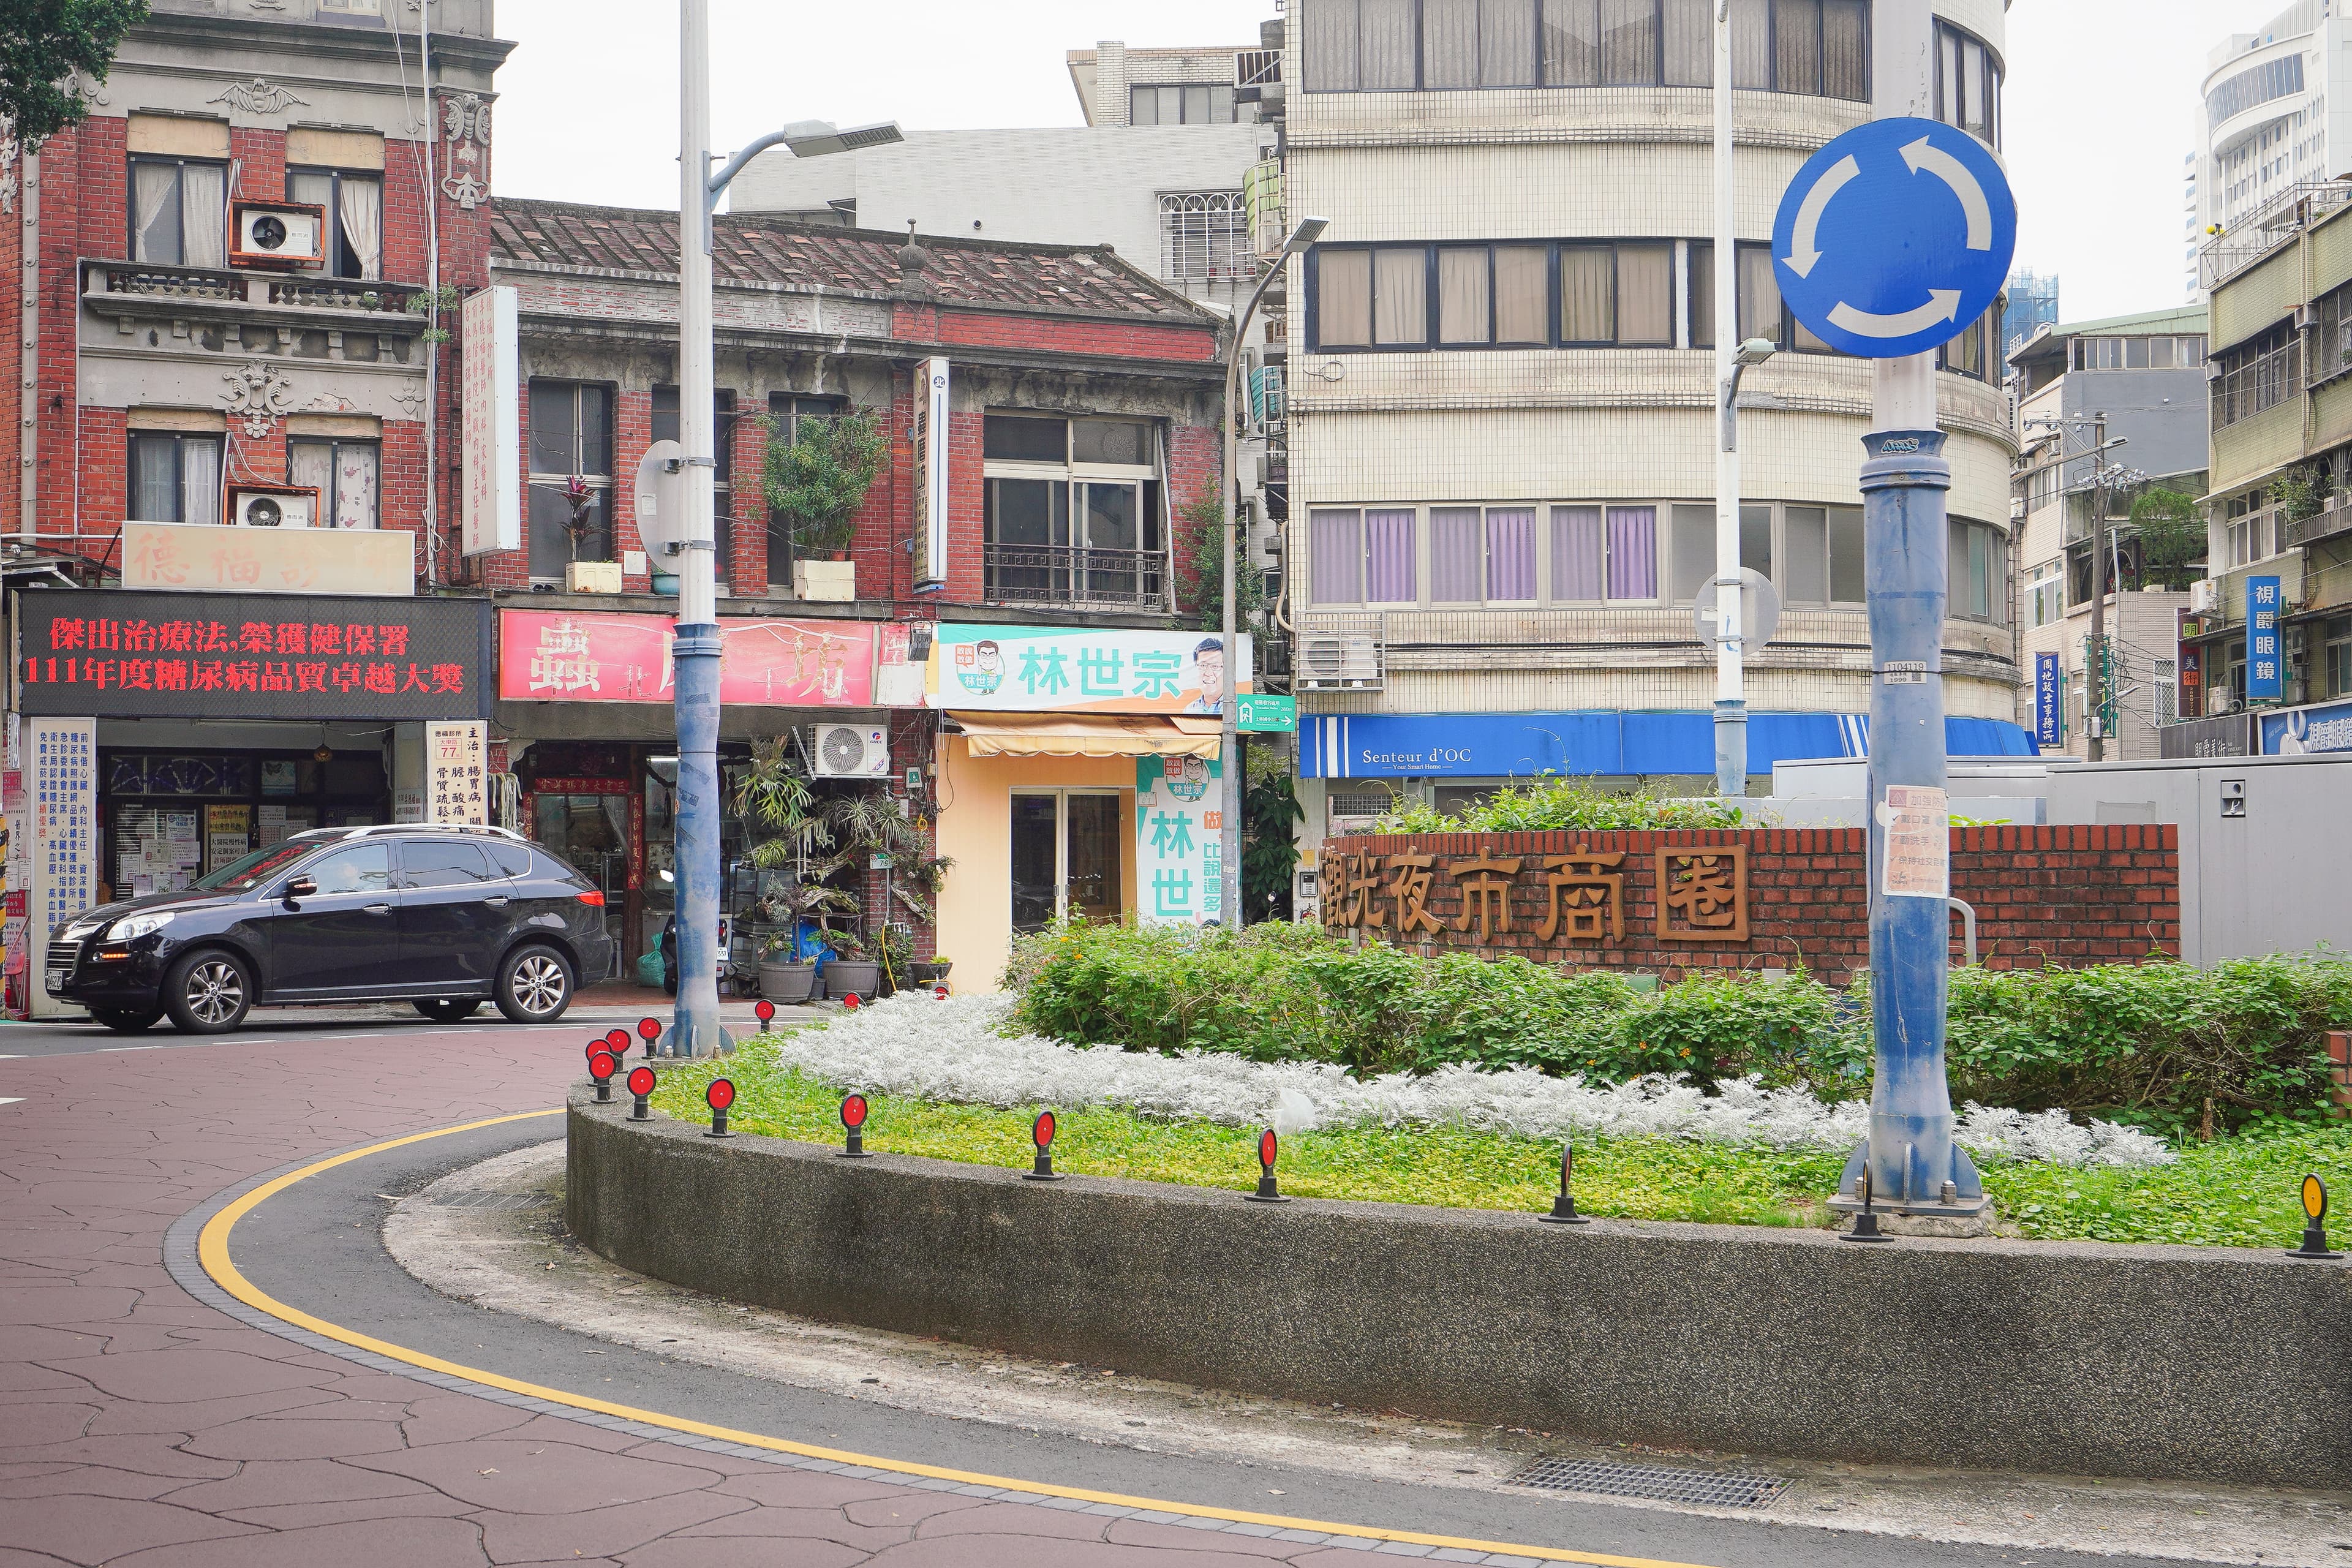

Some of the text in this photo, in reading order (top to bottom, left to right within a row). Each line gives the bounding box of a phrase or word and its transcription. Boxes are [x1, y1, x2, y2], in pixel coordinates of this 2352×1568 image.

[2255, 585, 2275, 681] 視爵眼鏡
[1018, 646, 1183, 699] 林世宗
[1888, 663, 1924, 672] 1104119
[25, 657, 464, 695] 111年度糖尿病品質卓越大獎
[964, 676, 998, 687] 林世宗
[441, 747, 456, 758] 77
[1363, 749, 1422, 763] Senteur
[1173, 785, 1202, 795] 林世宗
[1900, 835, 1929, 846] 勤洗手
[1203, 842, 1221, 912] 比說還多
[1319, 843, 1751, 943] 觀光夜市商圈
